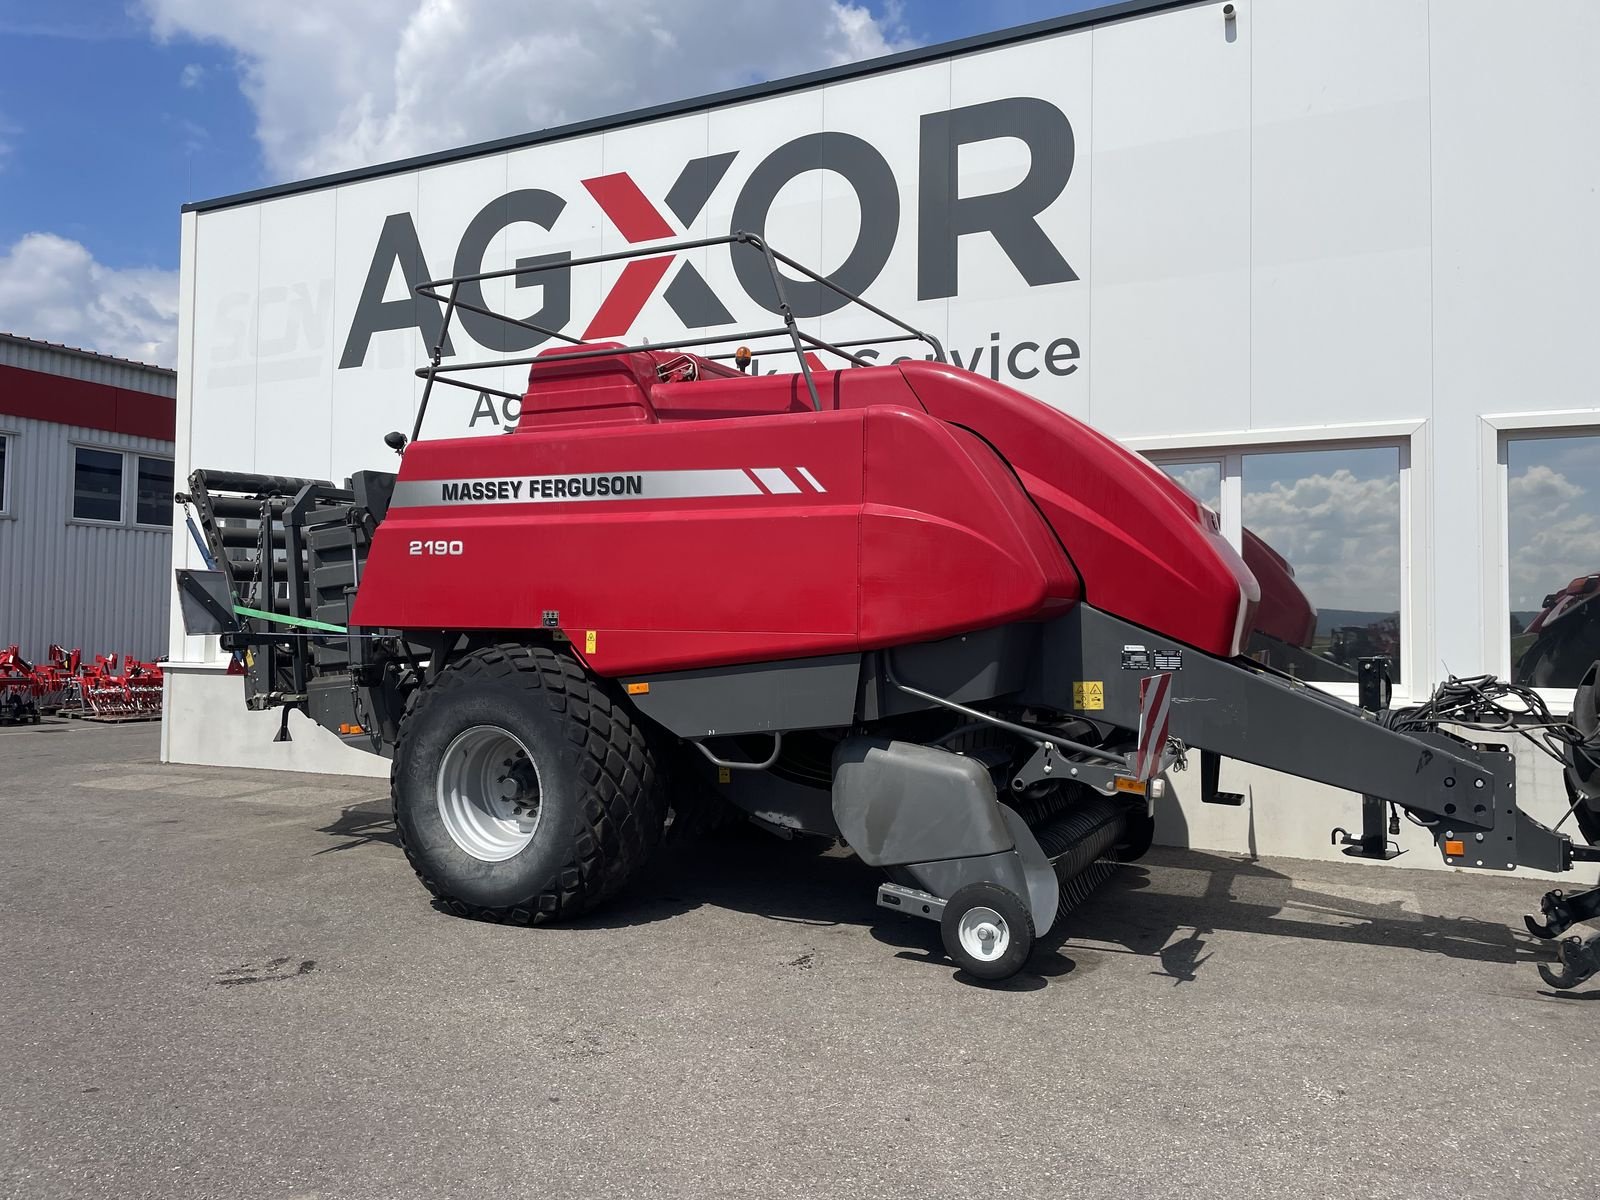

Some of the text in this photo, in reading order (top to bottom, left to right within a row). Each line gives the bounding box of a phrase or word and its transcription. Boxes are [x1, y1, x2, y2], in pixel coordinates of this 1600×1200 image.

[338, 96, 1080, 370] AGXOR
[441, 475, 643, 501] MASSEY FERGUSON
[408, 540, 465, 556] 2190
